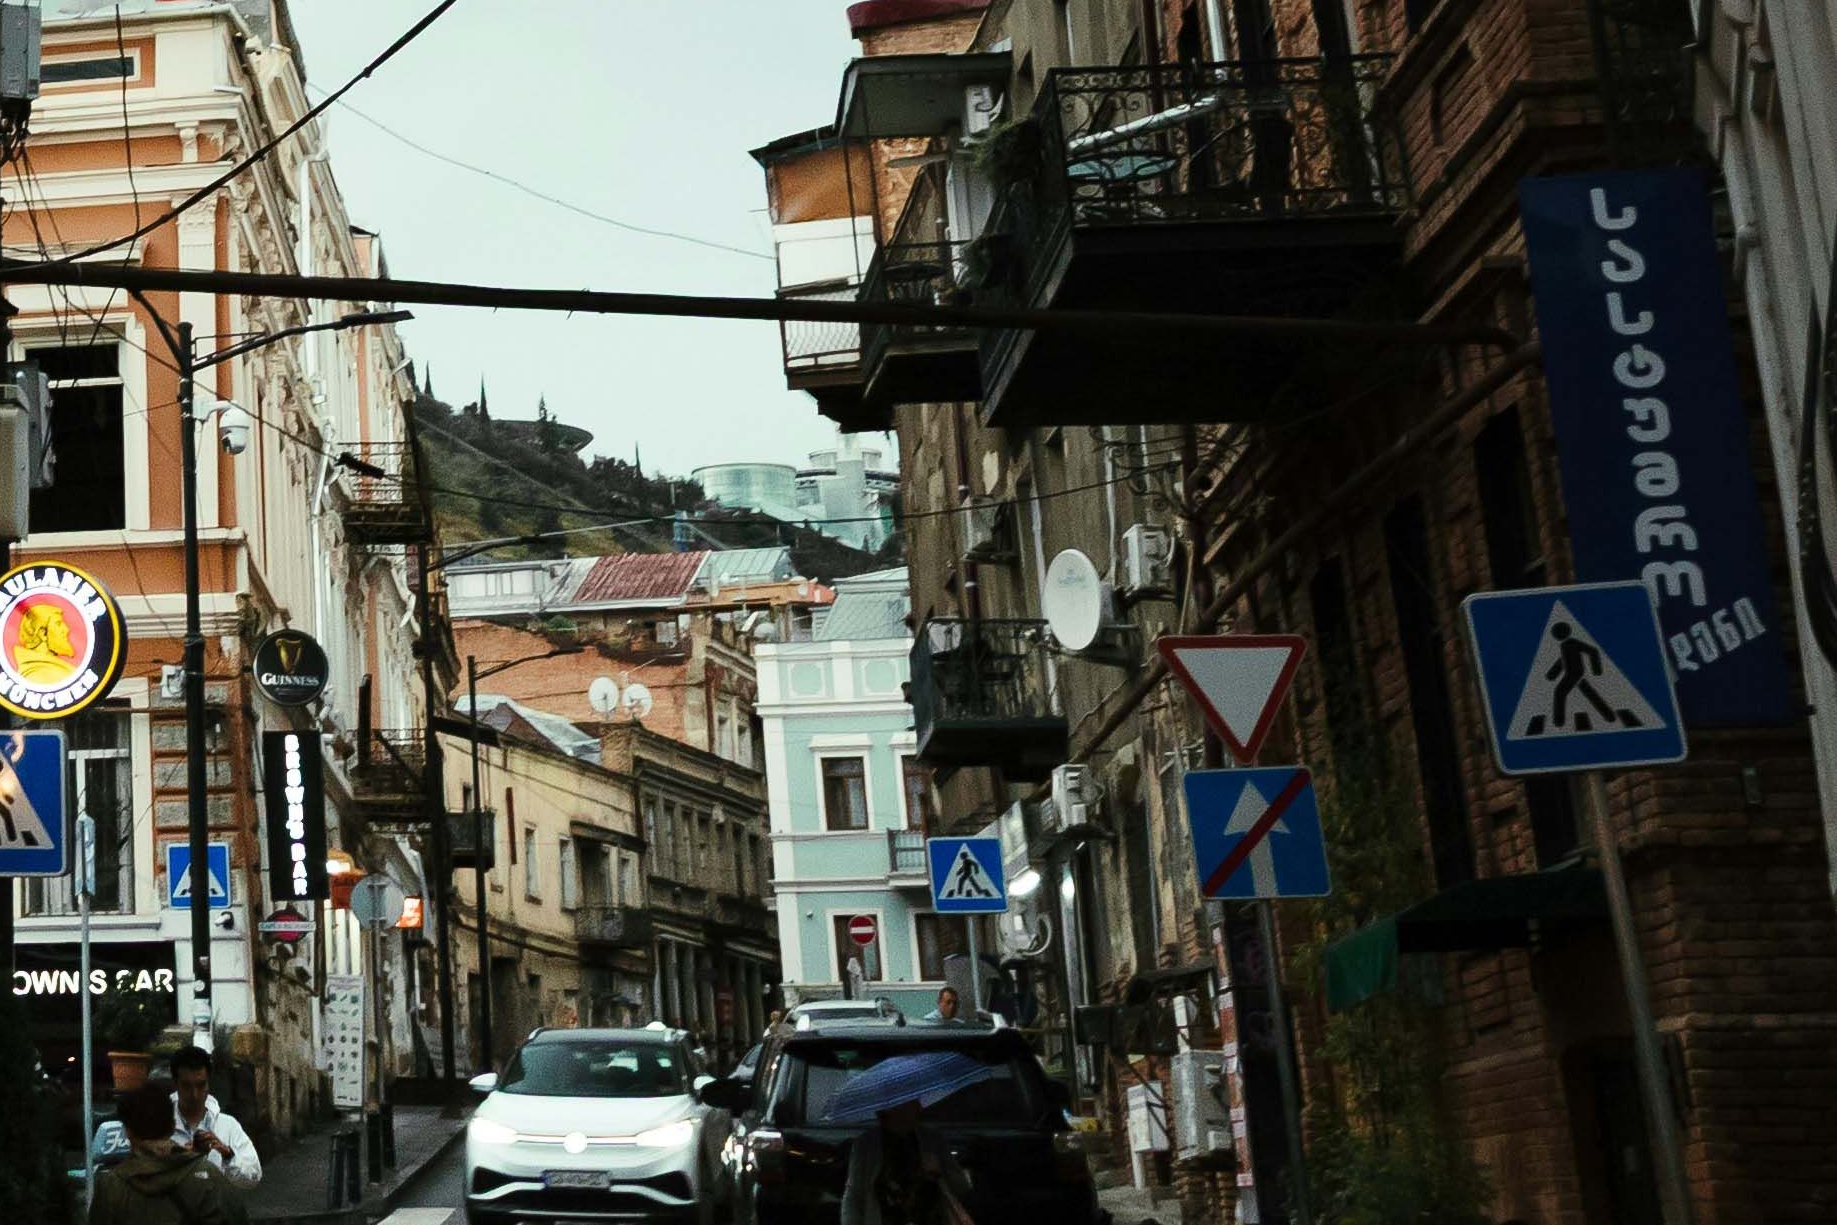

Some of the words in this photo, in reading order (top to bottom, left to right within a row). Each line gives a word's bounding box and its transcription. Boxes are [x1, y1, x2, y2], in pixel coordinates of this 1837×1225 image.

[1589, 187, 1708, 607] სასტუმრო
[260, 672, 320, 687] GUINNESS
[290, 842, 308, 896] BAR
